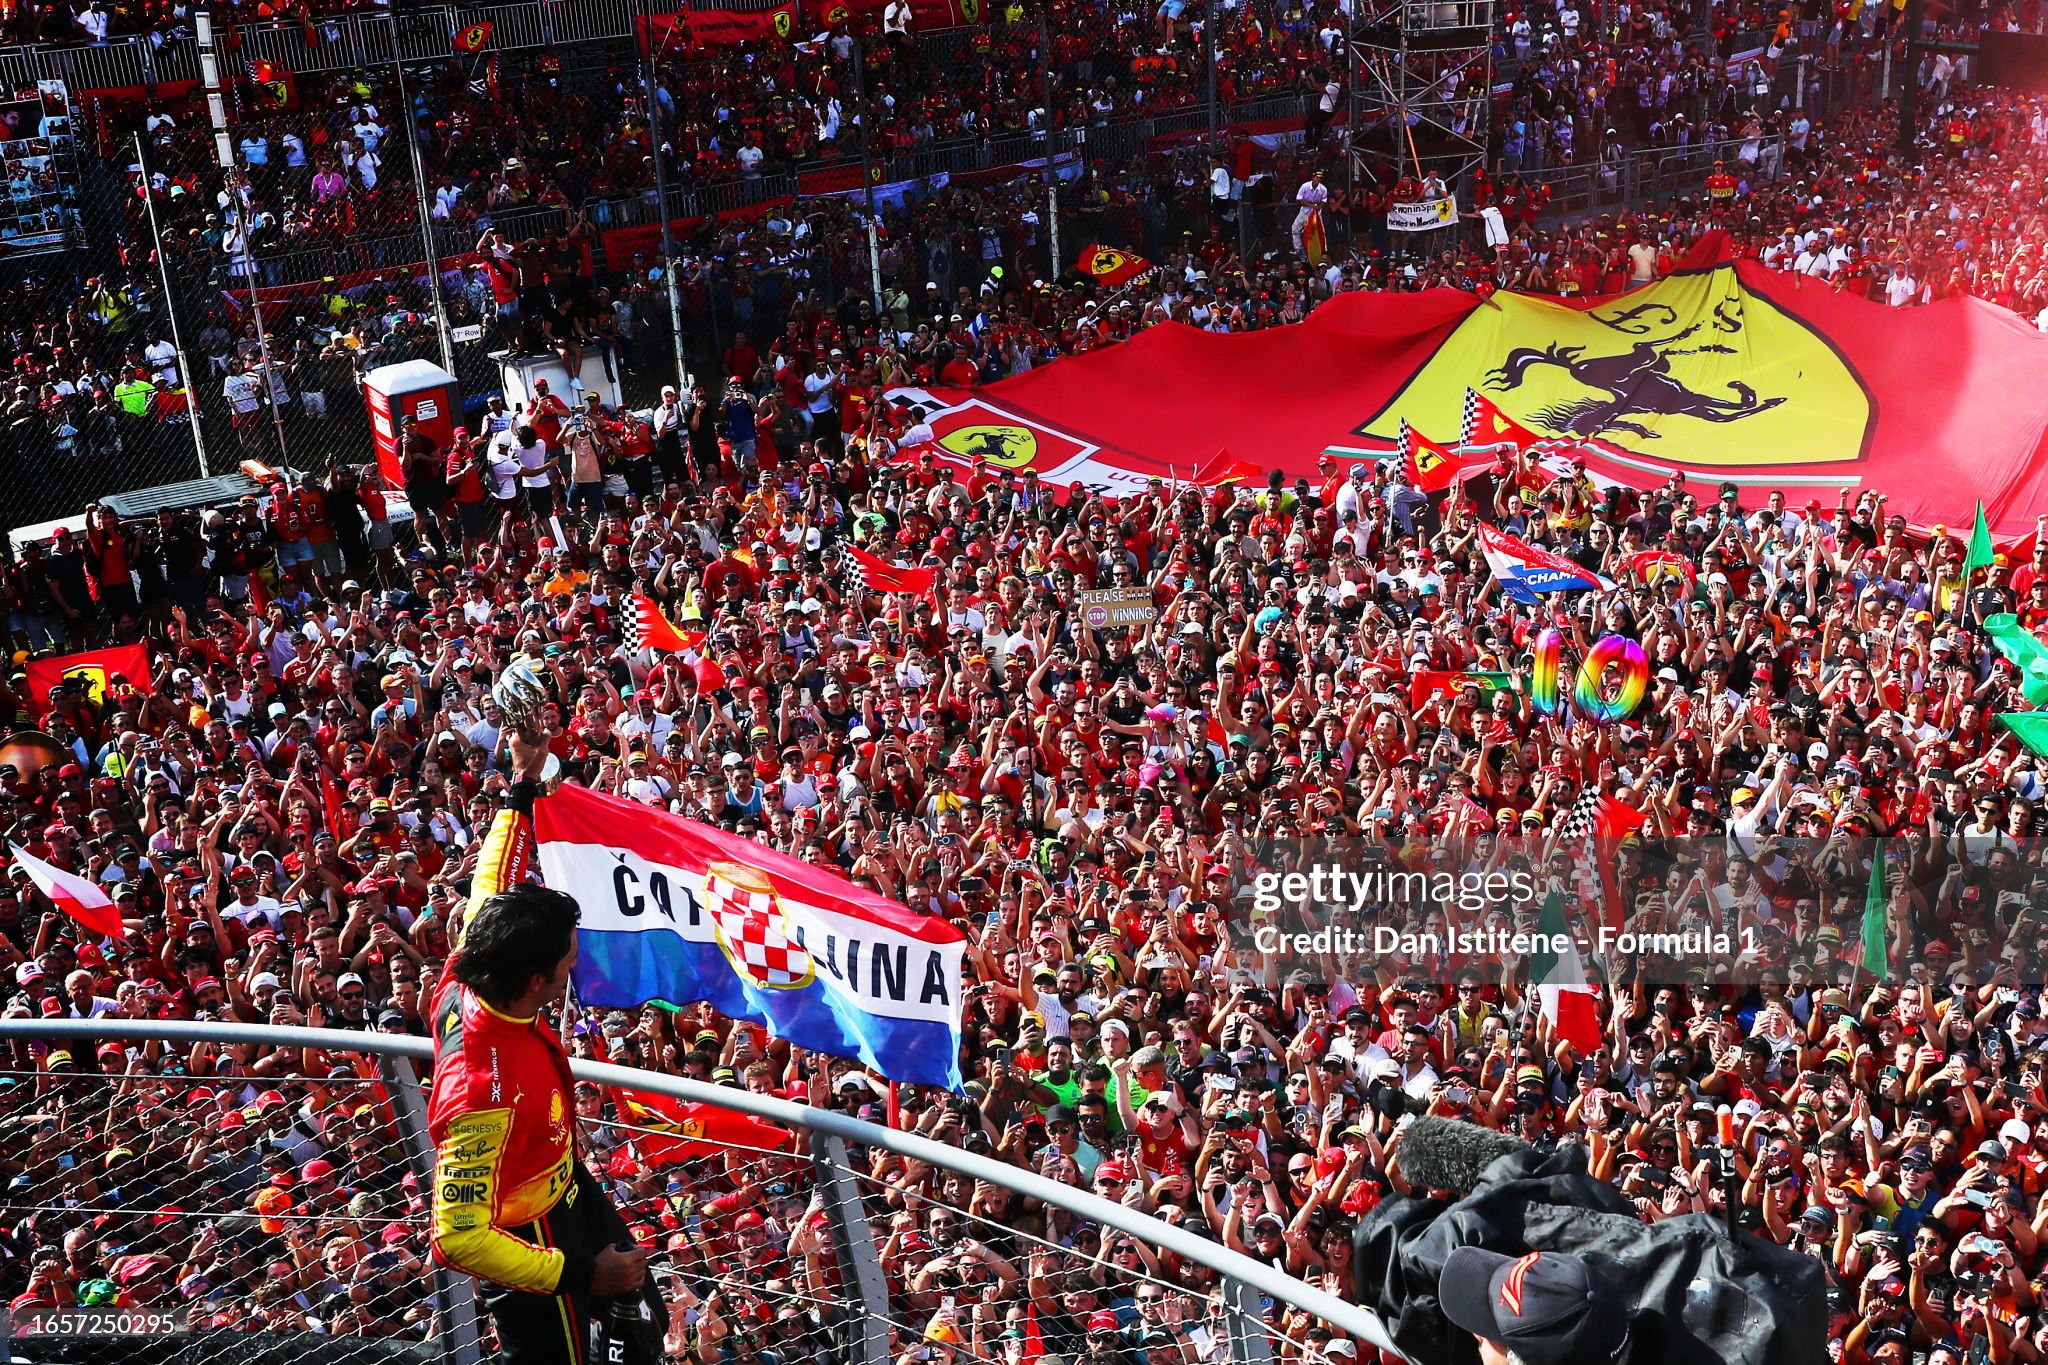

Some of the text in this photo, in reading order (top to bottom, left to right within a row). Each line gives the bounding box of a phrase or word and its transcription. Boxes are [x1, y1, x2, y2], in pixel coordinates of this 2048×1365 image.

[1420, 203, 1436, 214] Spa
[1083, 589, 1125, 604] PLEASE
[460, 1122, 502, 1134] GENESYS
[454, 1140, 497, 1162] Ray-Ban
[444, 1165, 492, 1179] PIRELLI
